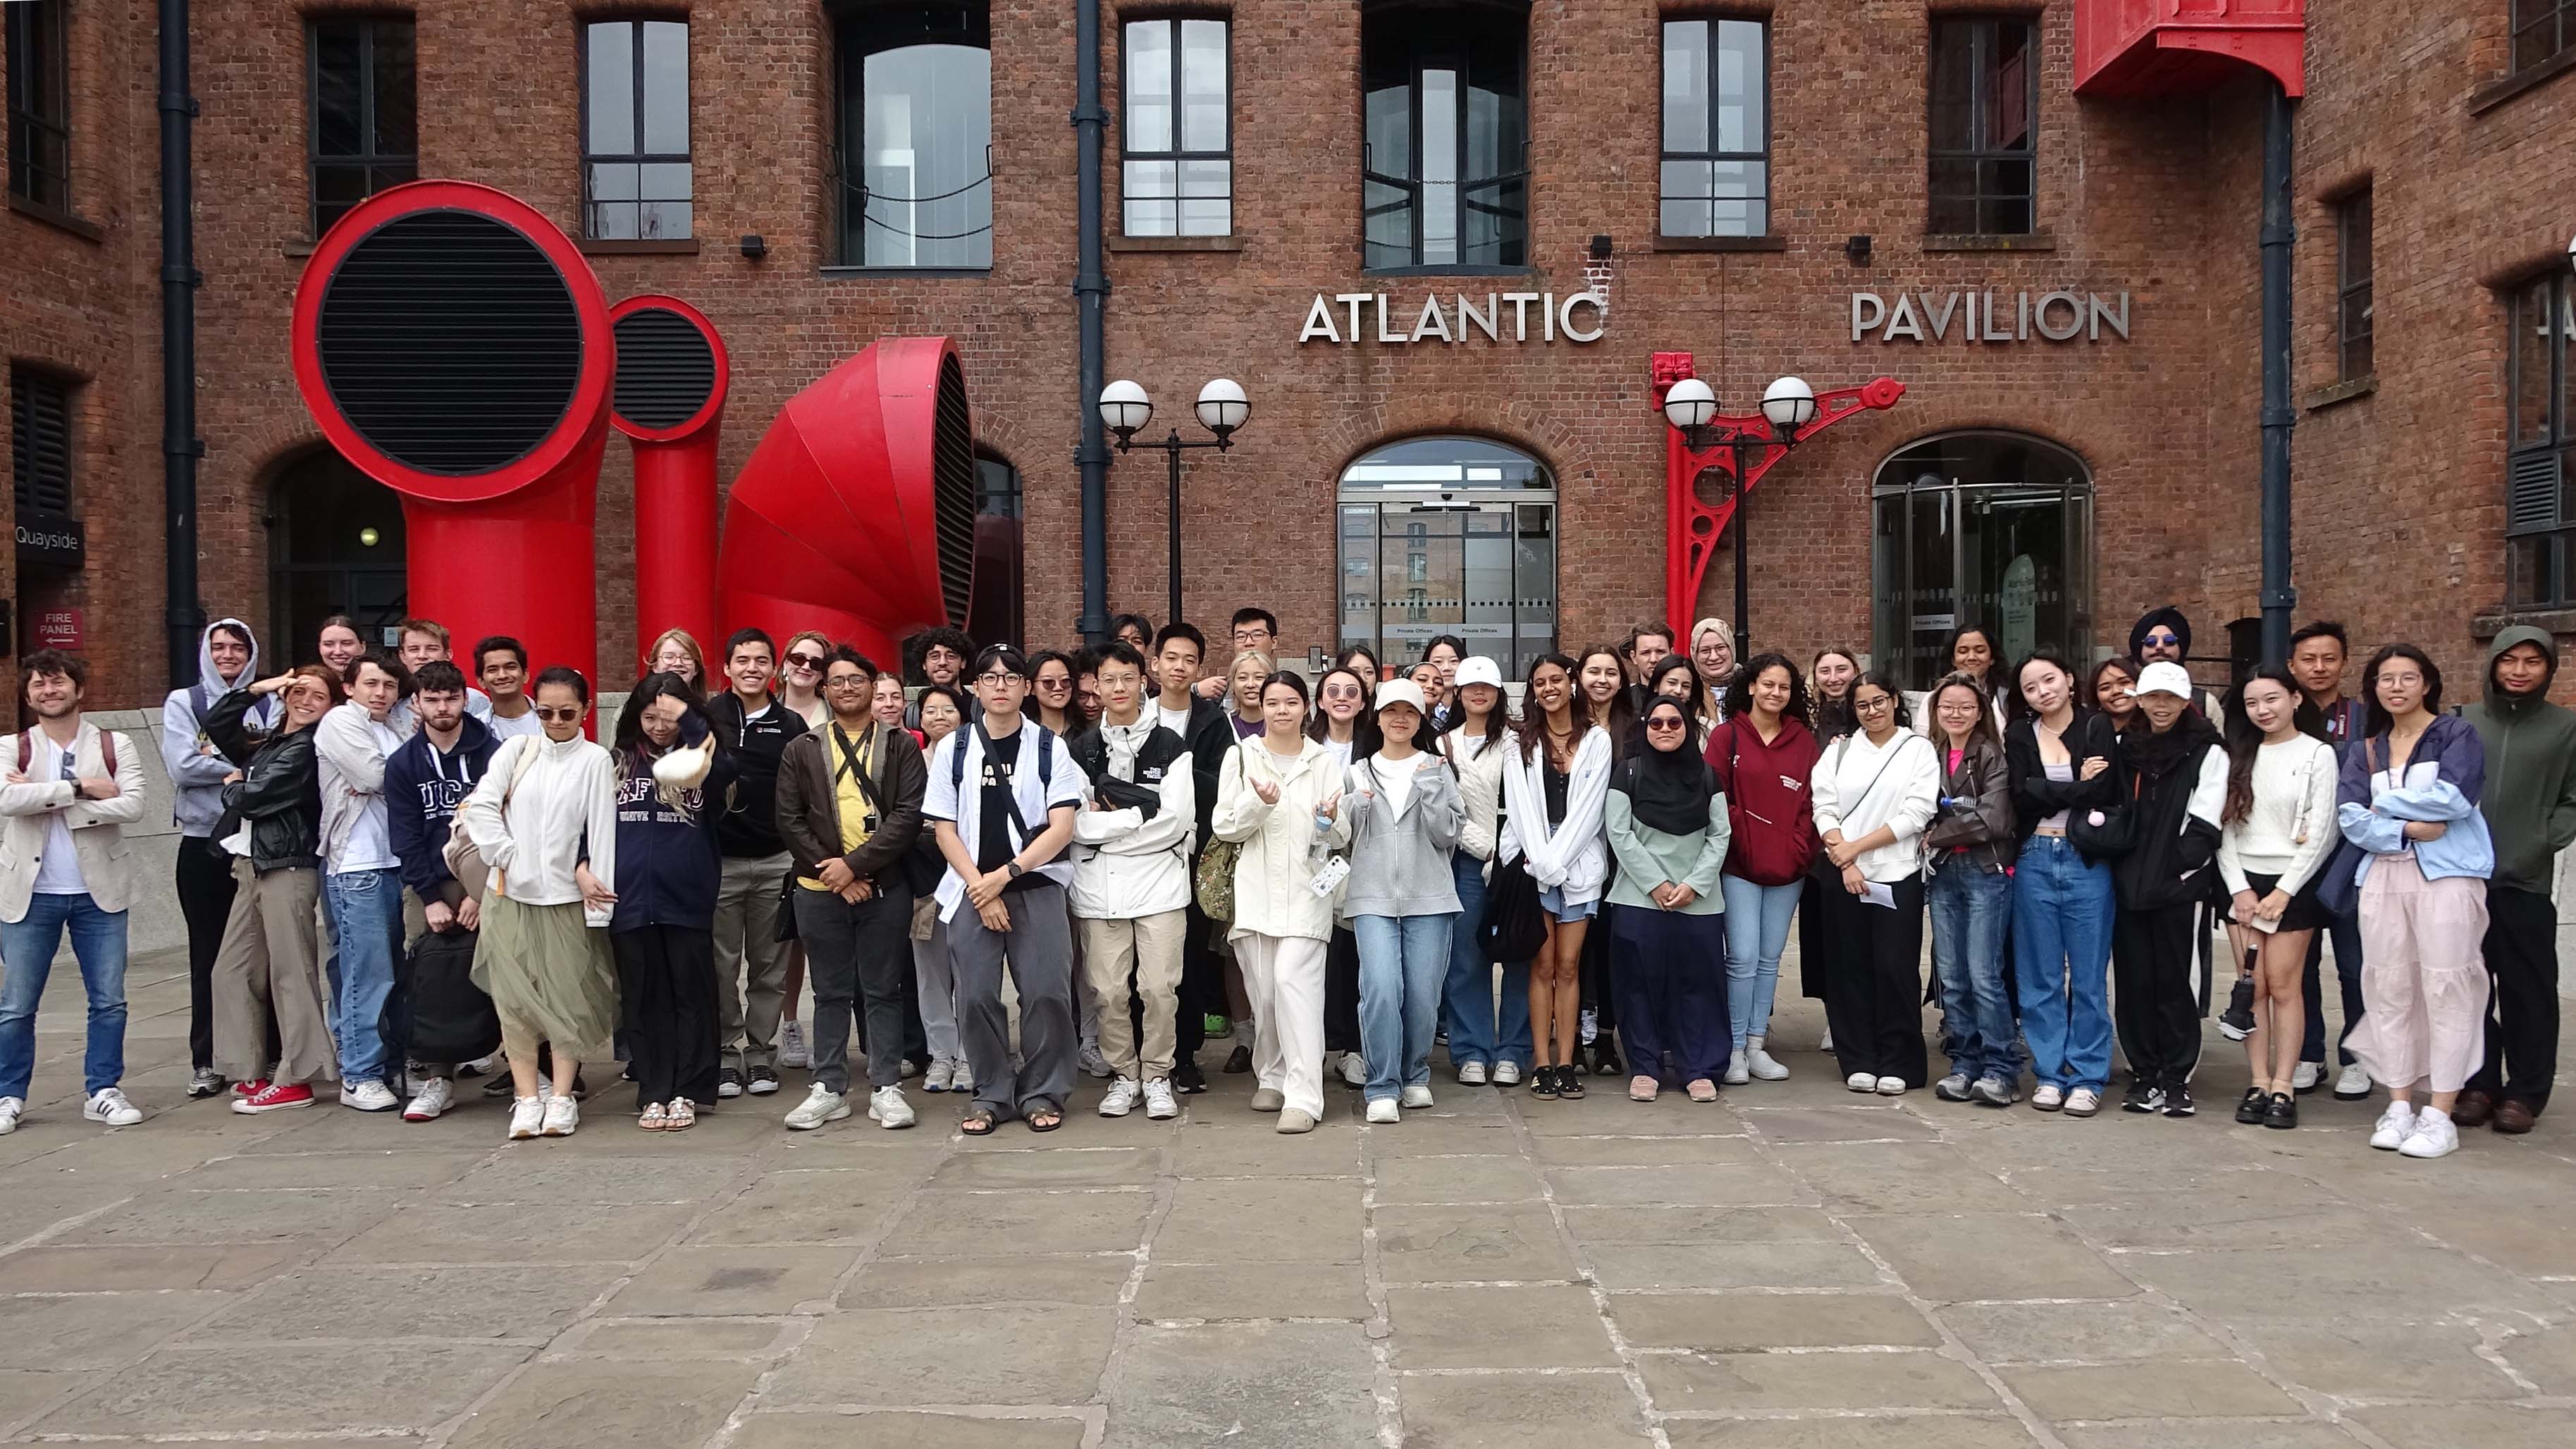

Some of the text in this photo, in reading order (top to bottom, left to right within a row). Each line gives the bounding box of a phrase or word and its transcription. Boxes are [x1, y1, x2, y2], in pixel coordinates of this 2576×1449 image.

[1298, 290, 2130, 343] ATLANTIC PAVILION
[16, 526, 78, 550] Quayside
[45, 613, 73, 623] FIRE
[39, 624, 78, 634] PANEL
